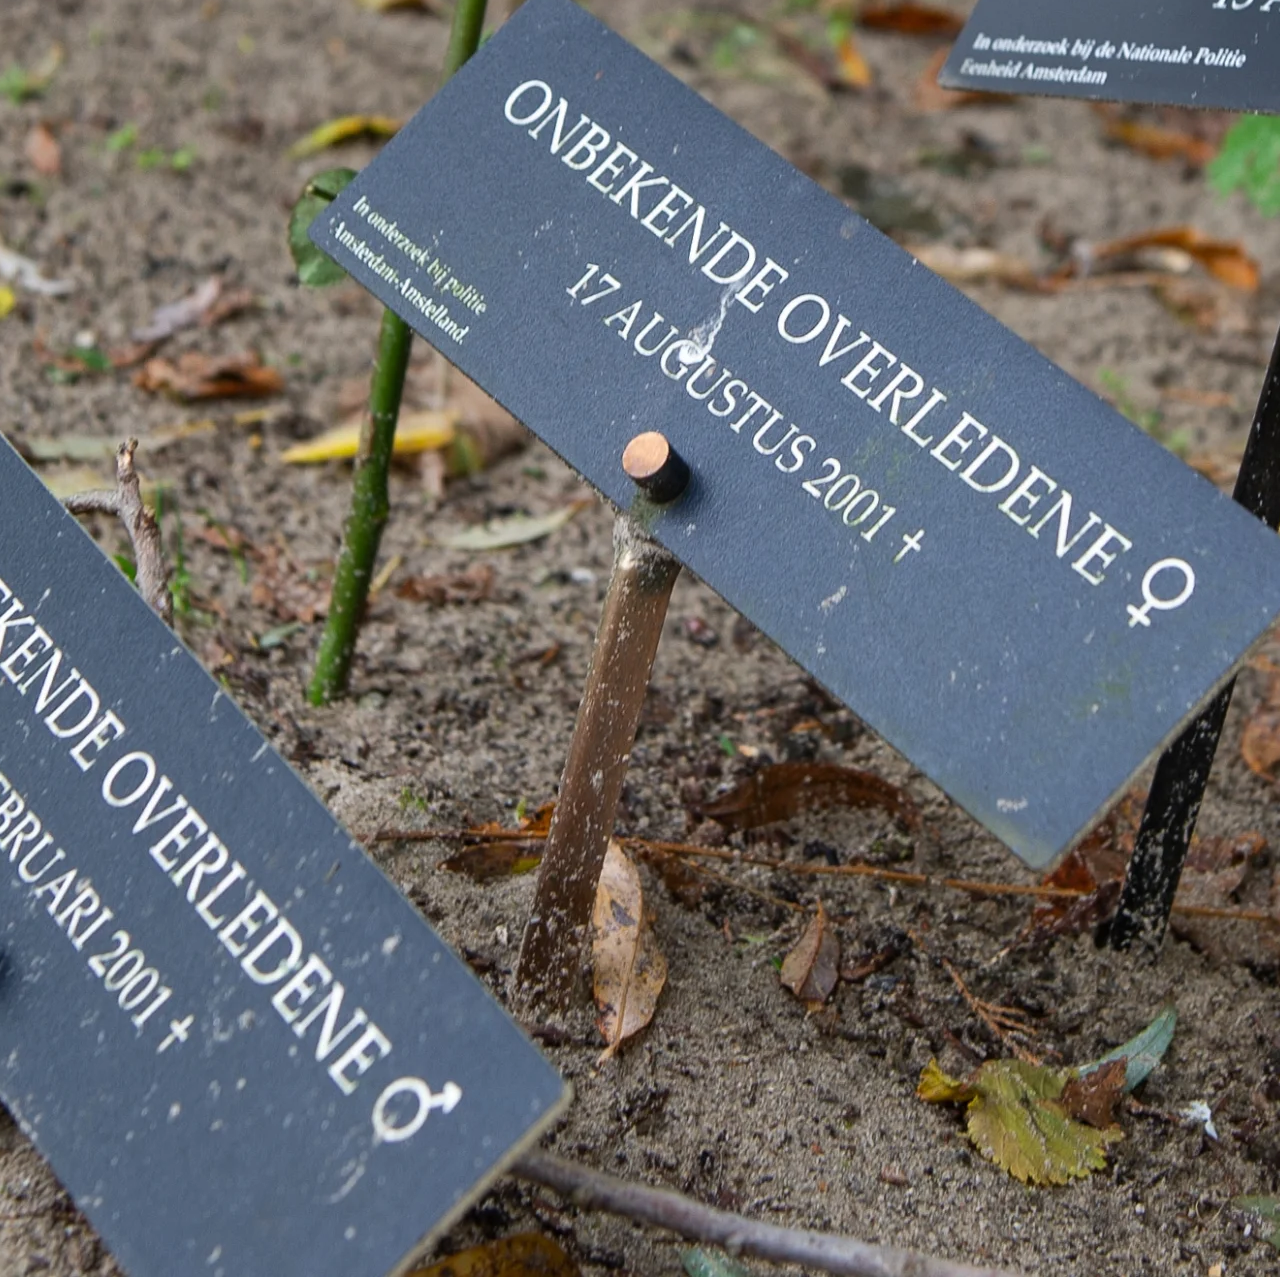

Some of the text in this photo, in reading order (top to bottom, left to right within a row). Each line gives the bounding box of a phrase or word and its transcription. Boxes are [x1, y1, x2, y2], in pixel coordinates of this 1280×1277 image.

[960, 58, 1108, 85] Eenheid Amsterdam
[972, 32, 1247, 68] In onderzoek bij de Nationale Politie
[352, 195, 487, 315] In onderzoek bij politie
[504, 79, 1133, 587] ONBEKENDE OVERLEDENE
[566, 263, 897, 543] 17 AUGUSTUS 2001
[88, 930, 172, 1030] 2001
[101, 750, 392, 1096] OVERLEDENE
